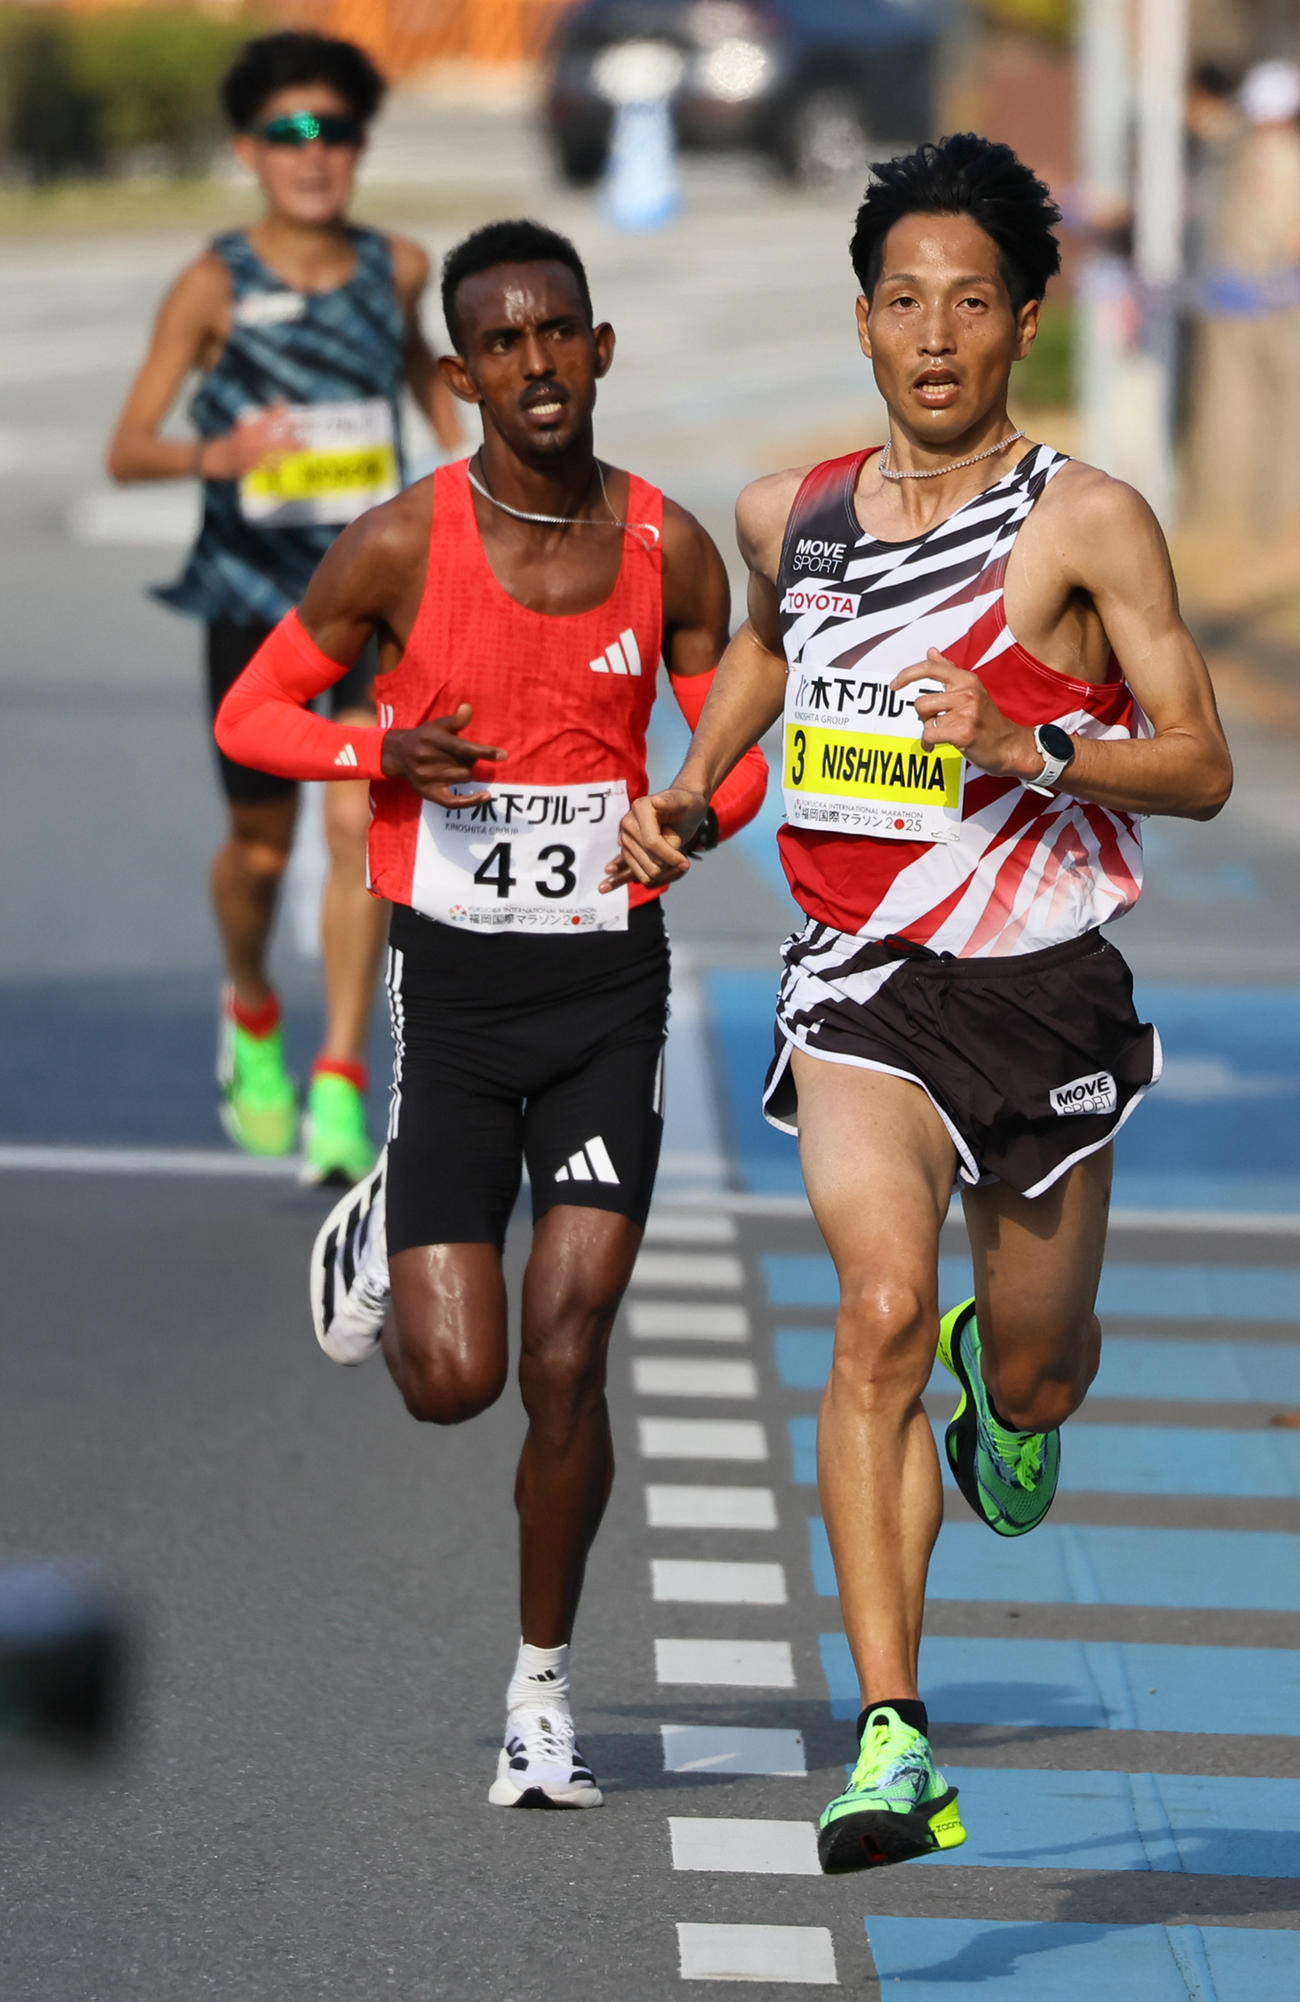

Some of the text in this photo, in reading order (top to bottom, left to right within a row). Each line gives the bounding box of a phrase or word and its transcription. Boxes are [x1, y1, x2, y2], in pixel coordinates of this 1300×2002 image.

[796, 539, 847, 559] MOVE
[793, 555, 842, 574] SPORT
[788, 593, 853, 613] TOYOTA
[821, 714, 849, 725] GROUP
[792, 730, 945, 791] 3 NISHIYAMA
[828, 803, 878, 815] INTERNATIONAL
[881, 809, 923, 819] MARATHON
[474, 842, 576, 898] 43
[1056, 1076, 1110, 1107] MOVE
